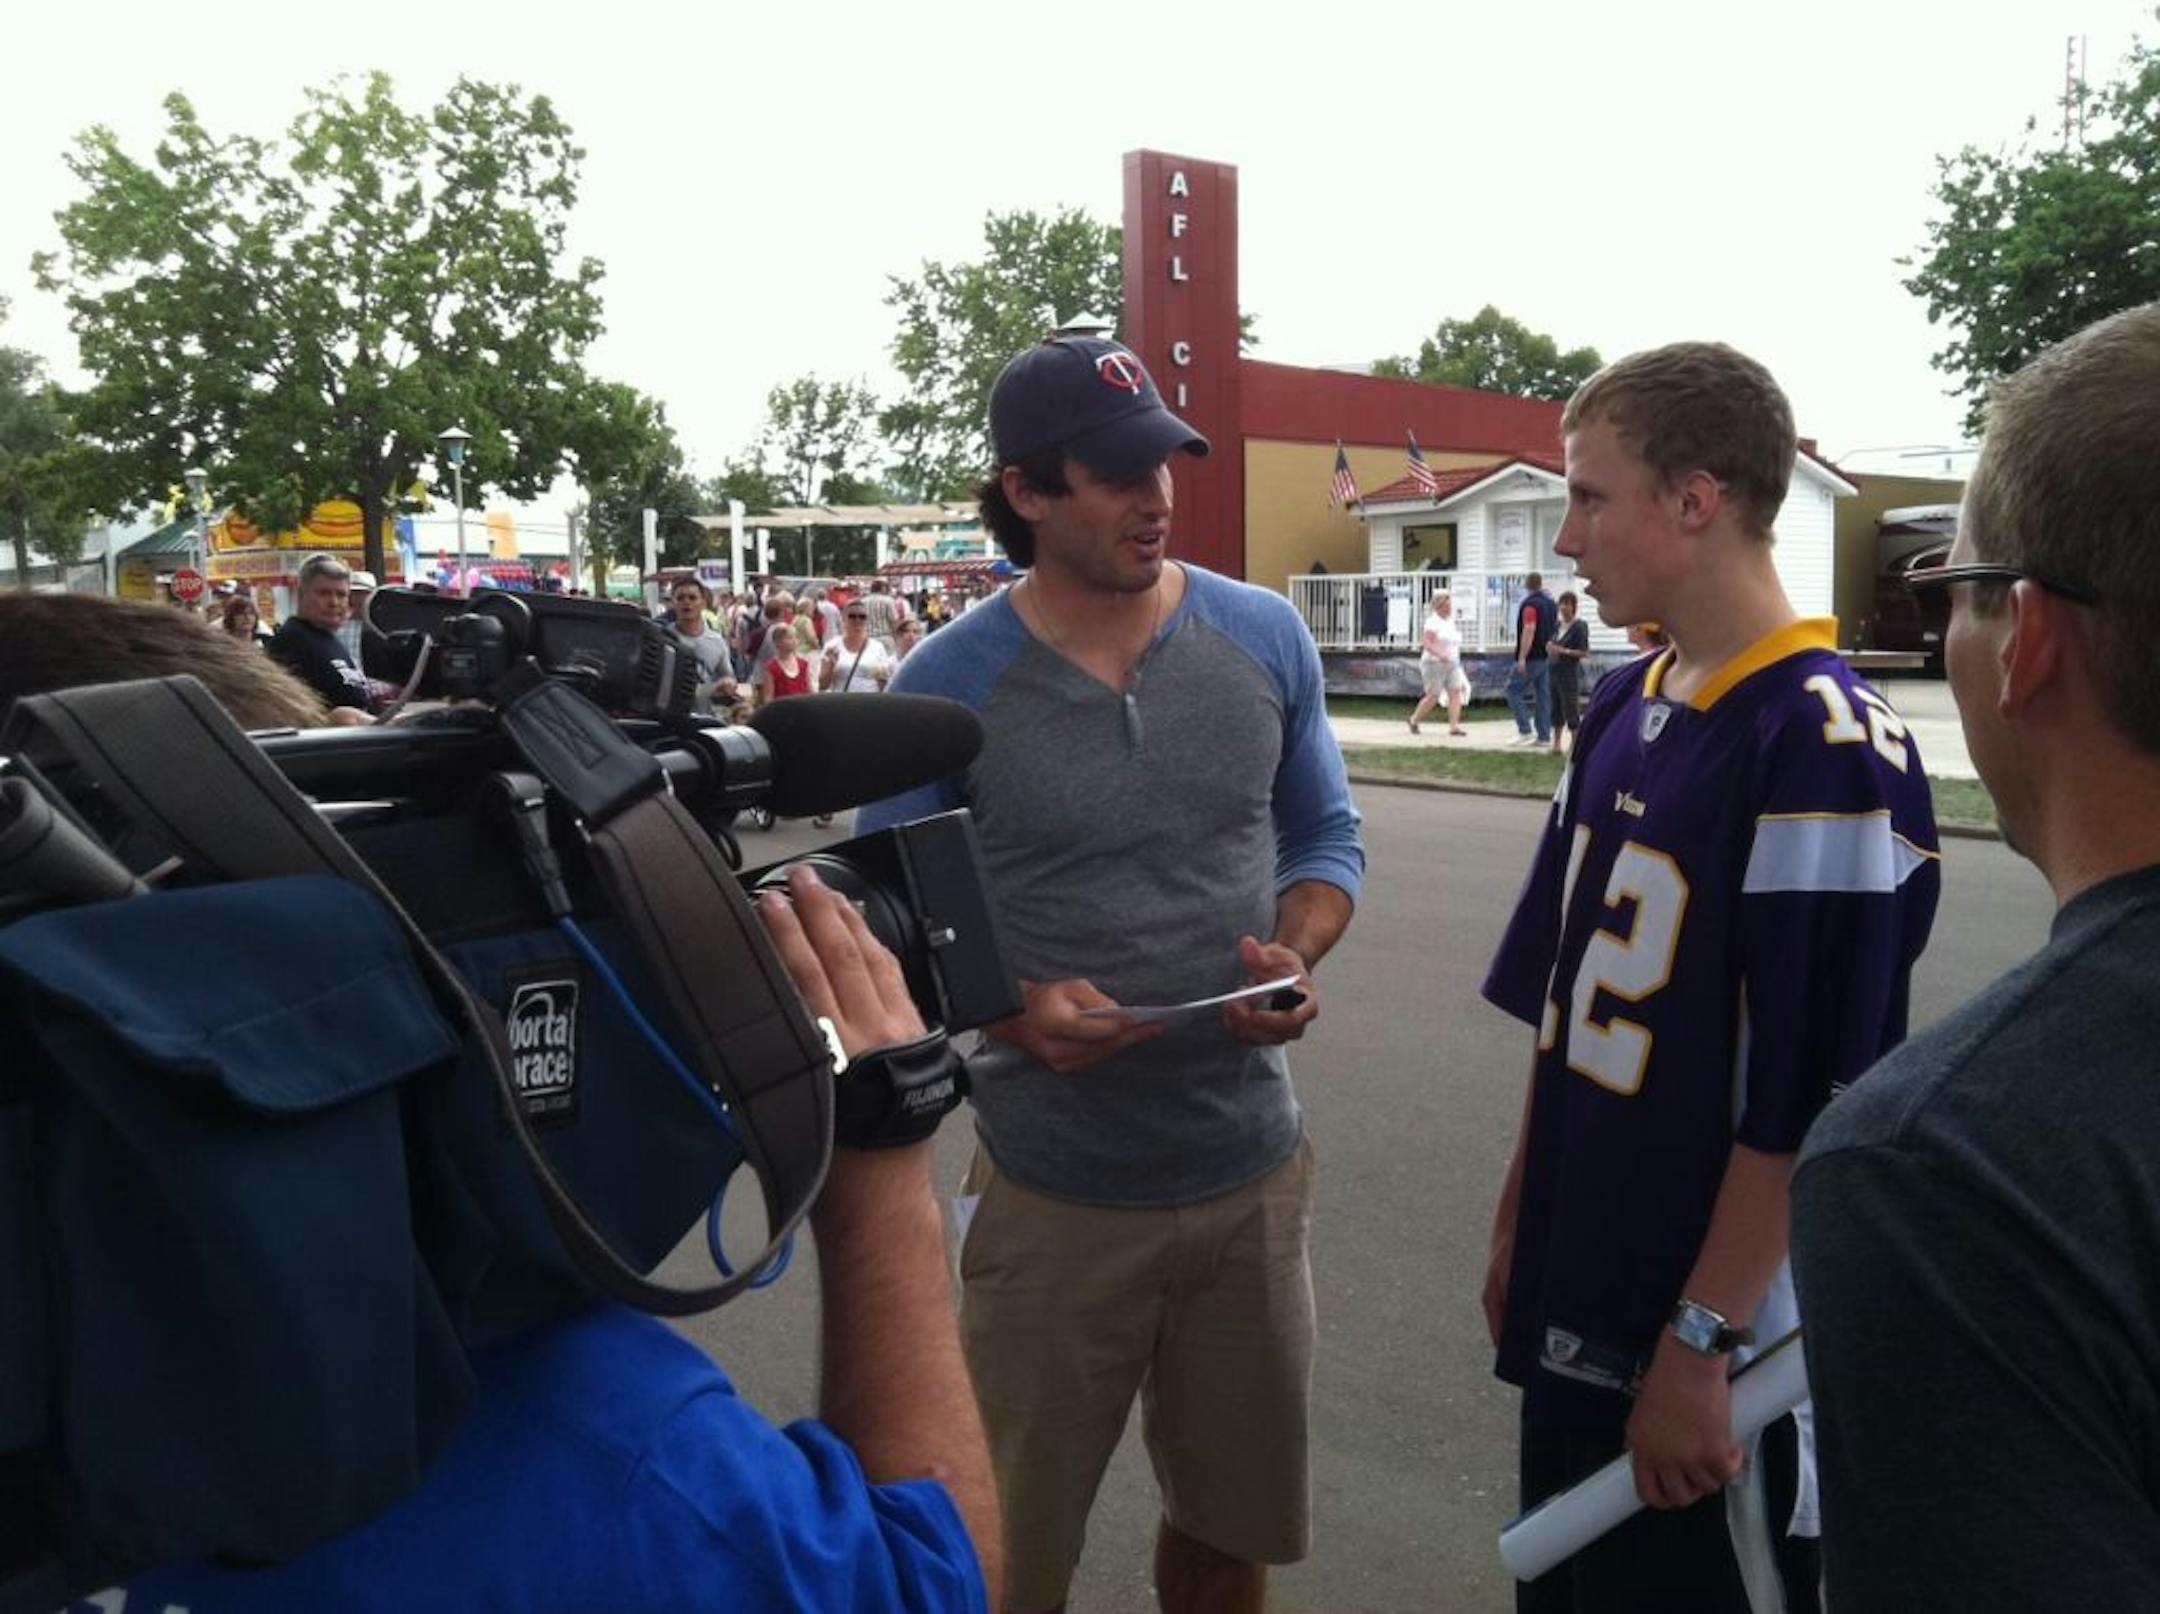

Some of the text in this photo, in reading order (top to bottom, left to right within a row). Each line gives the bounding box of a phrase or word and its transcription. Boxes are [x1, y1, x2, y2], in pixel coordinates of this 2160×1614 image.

[1169, 172, 1189, 281] AFL
[175, 577, 202, 592] STOP
[1803, 674, 1909, 775] 12
